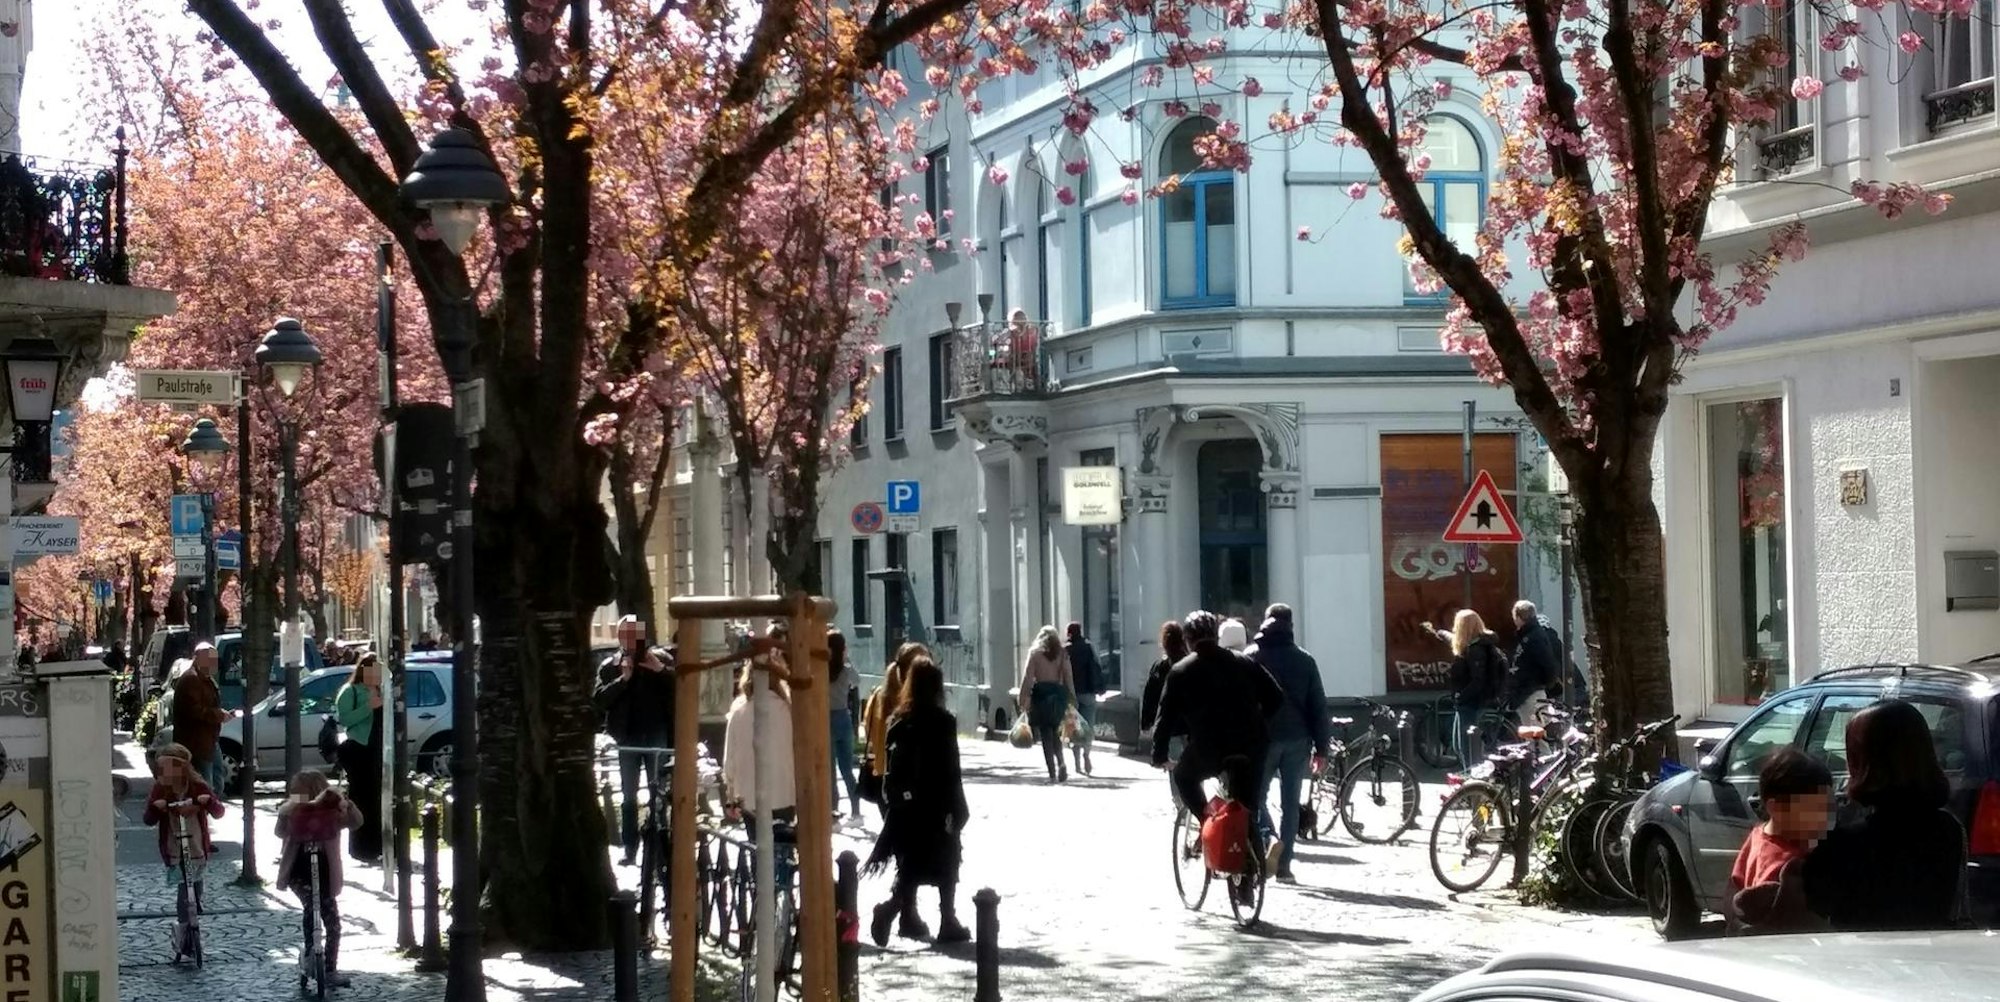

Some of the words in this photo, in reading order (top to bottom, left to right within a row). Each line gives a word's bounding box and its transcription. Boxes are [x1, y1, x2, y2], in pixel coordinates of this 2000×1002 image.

[20, 377, 47, 389] früh
[157, 377, 212, 395] Paulstraße
[894, 484, 913, 510] P
[181, 500, 202, 530] P
